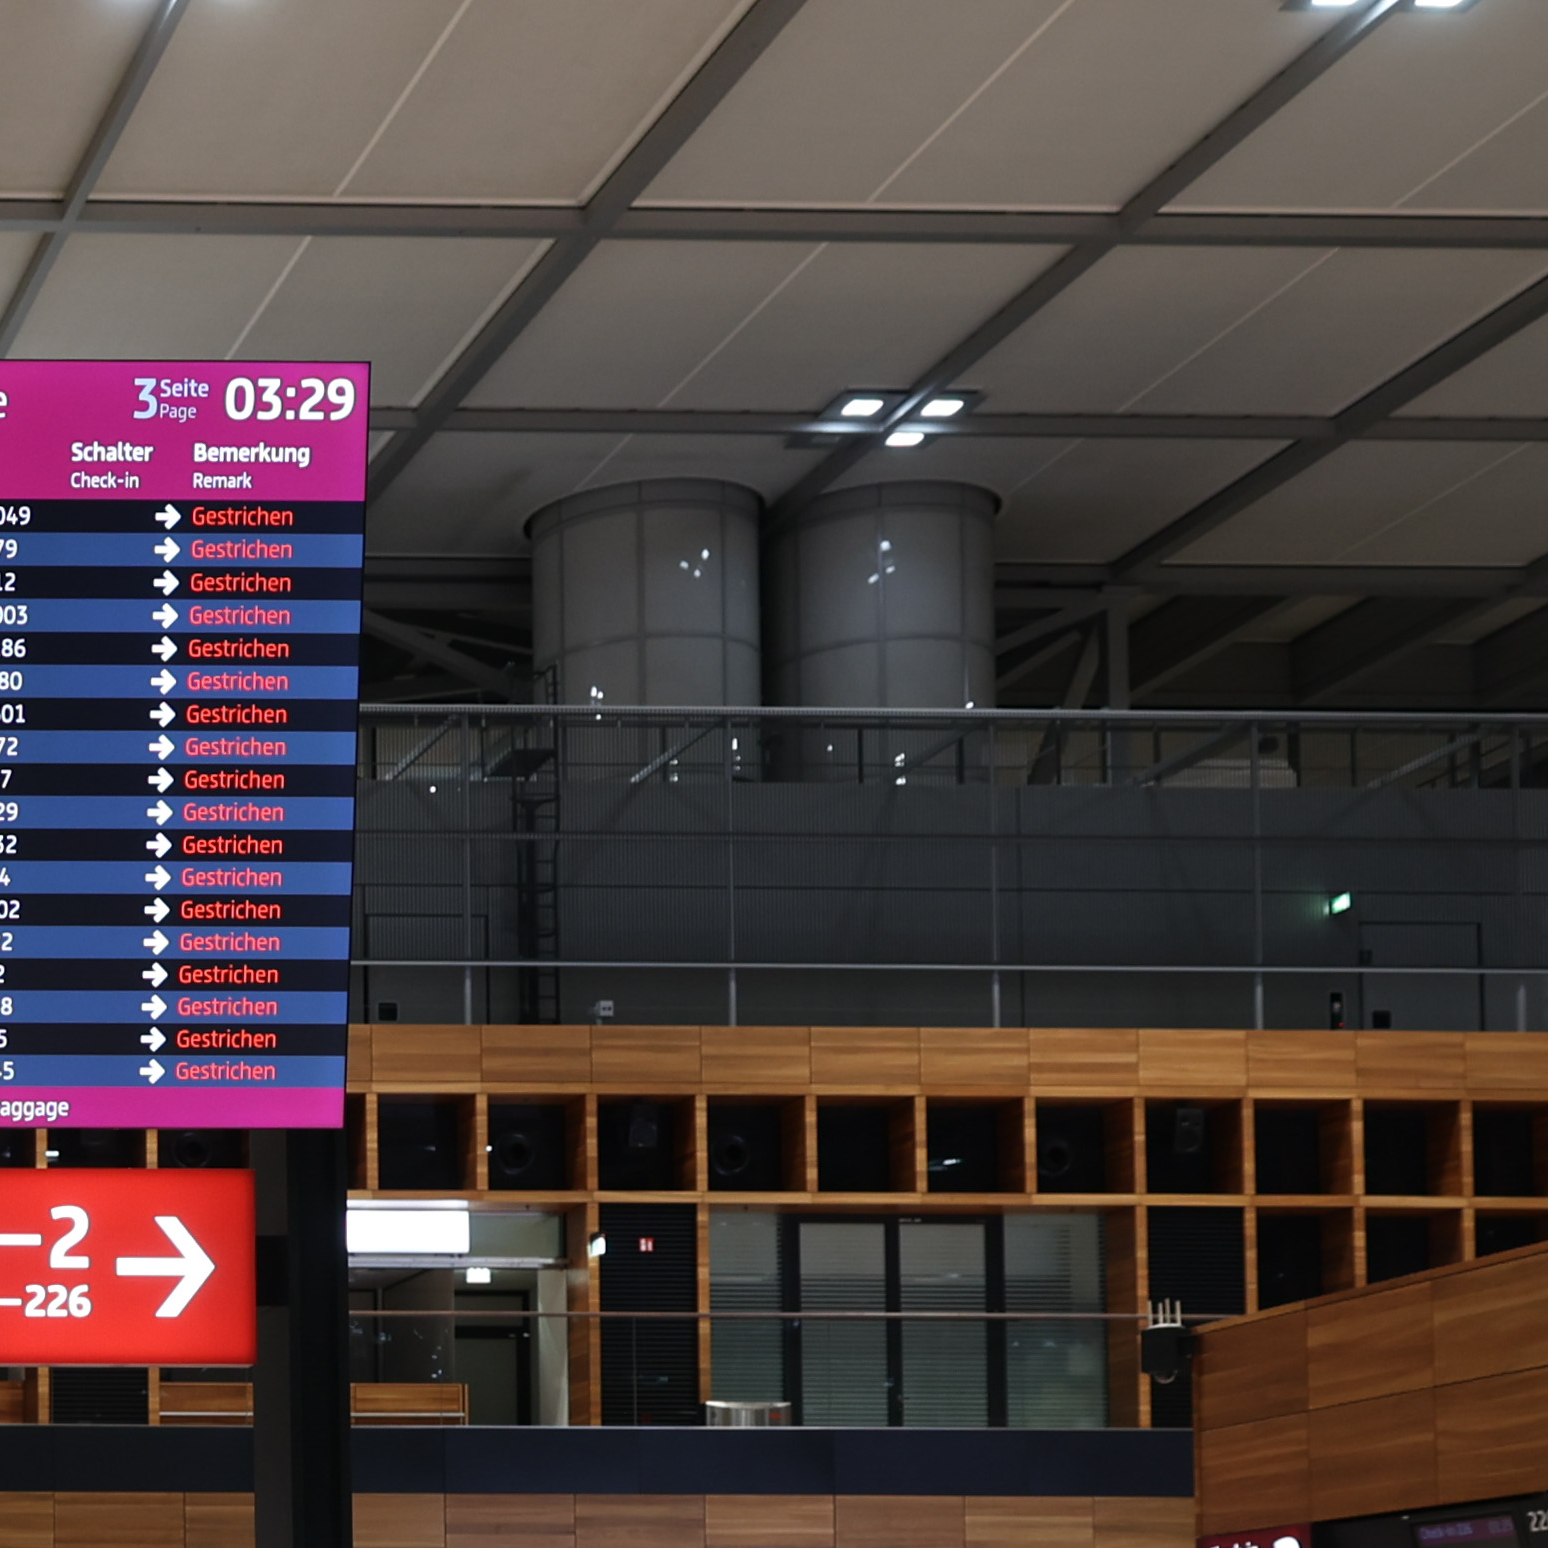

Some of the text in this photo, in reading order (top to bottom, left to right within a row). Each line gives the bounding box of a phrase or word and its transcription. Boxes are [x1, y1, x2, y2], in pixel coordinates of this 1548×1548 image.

[133, 378, 209, 419] 3 Seite
[226, 378, 354, 420] 03:29
[160, 403, 196, 423] Page
[186, 704, 287, 724] Gestrichen
[181, 900, 281, 919] Gestrichen
